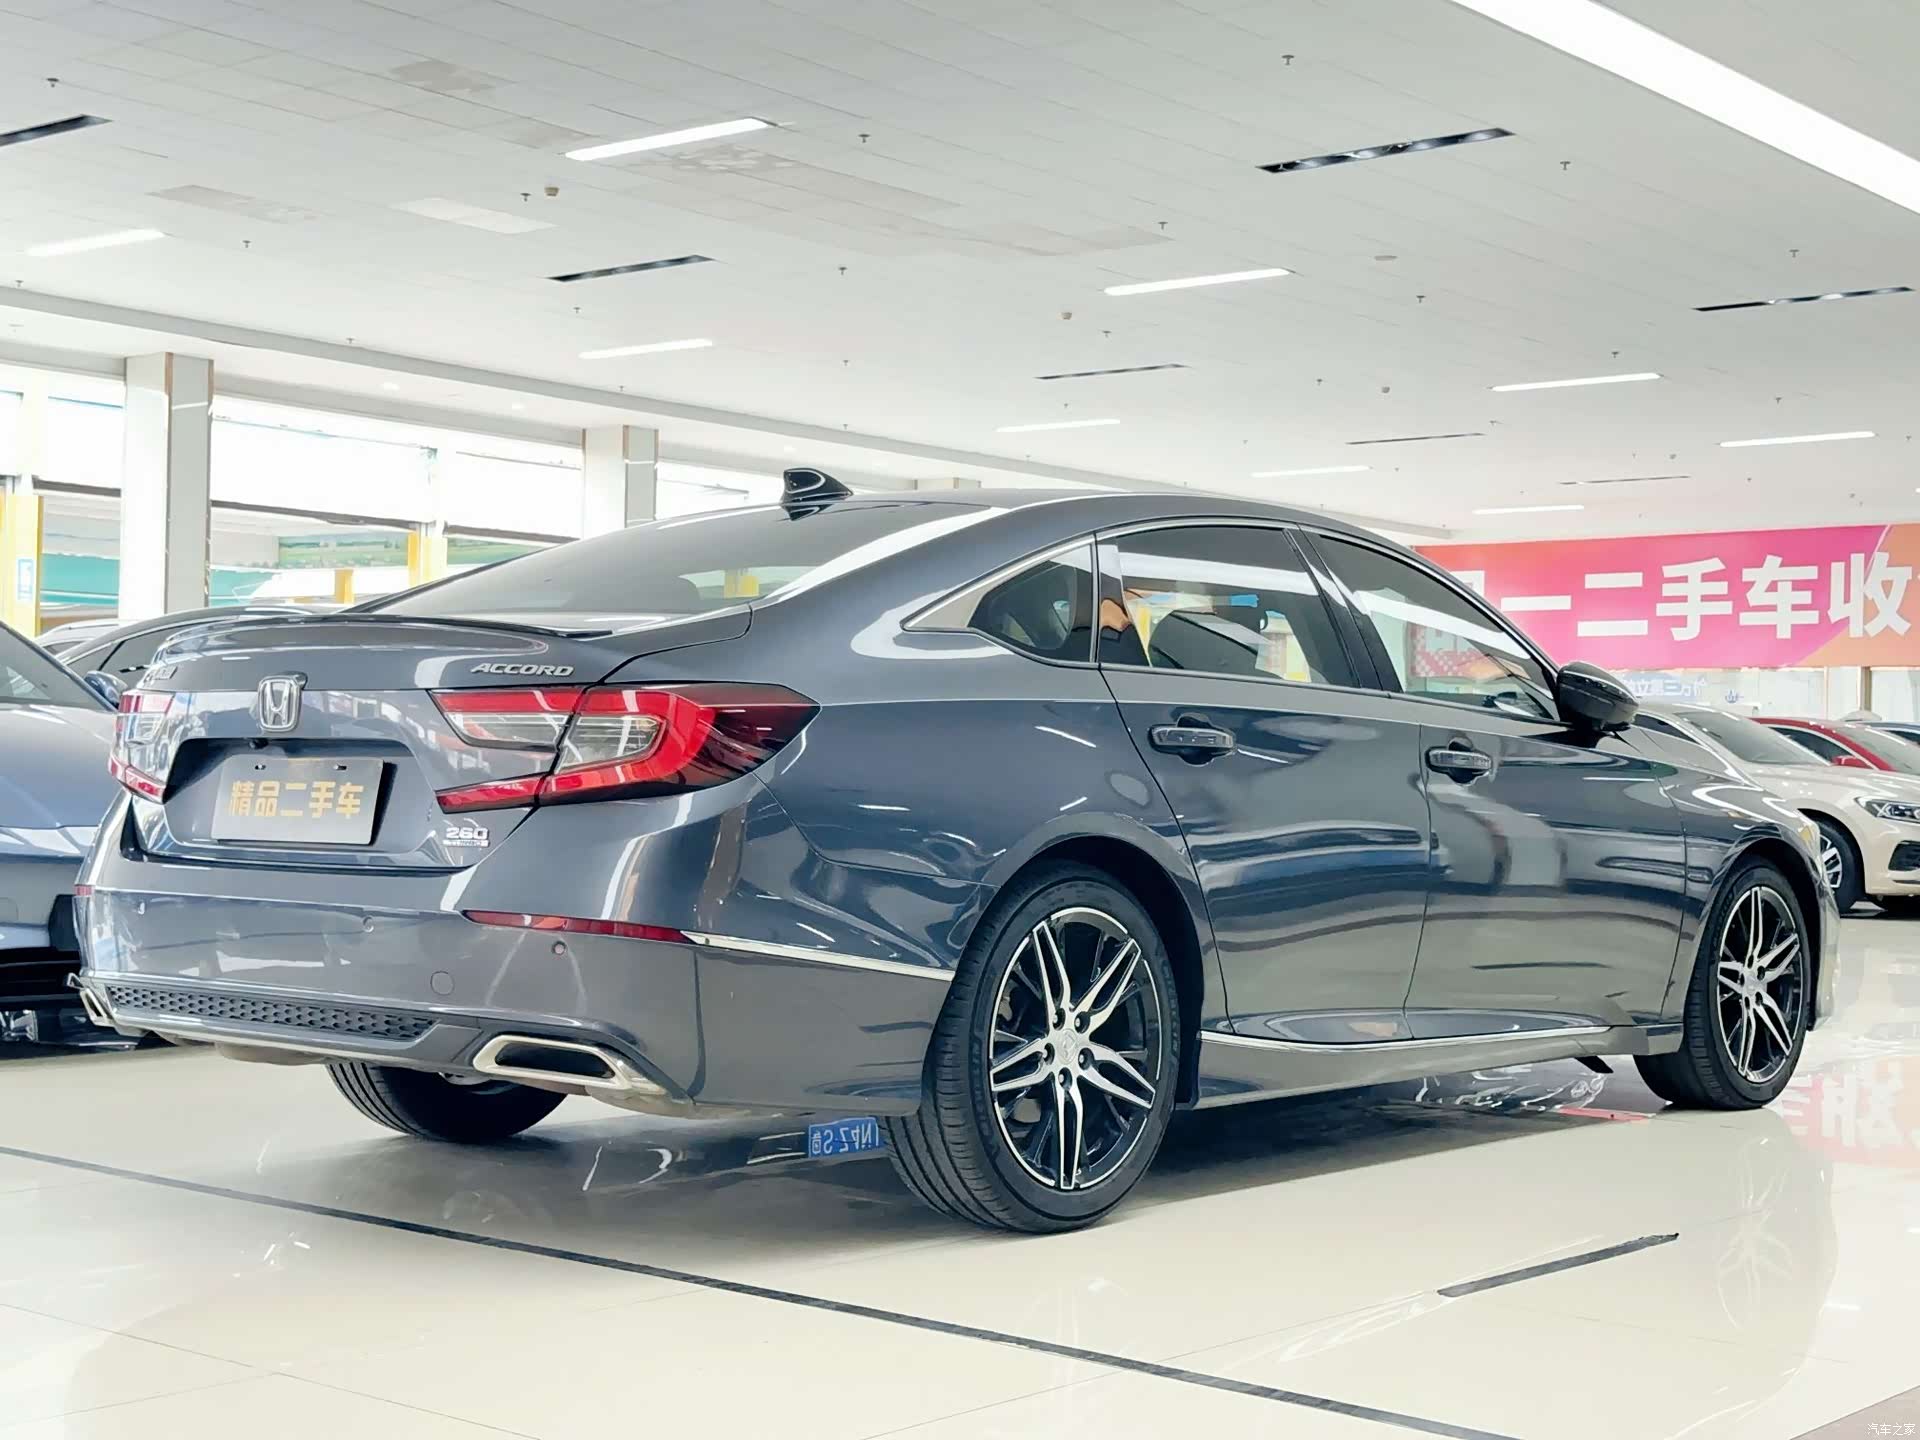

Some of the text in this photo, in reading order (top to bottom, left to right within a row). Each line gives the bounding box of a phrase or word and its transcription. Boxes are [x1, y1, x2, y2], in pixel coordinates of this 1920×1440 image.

[1449, 552, 1919, 641] 一二手车收
[470, 662, 574, 677] ACCORD
[229, 780, 364, 819] 精品二手车
[446, 827, 488, 840] 260
